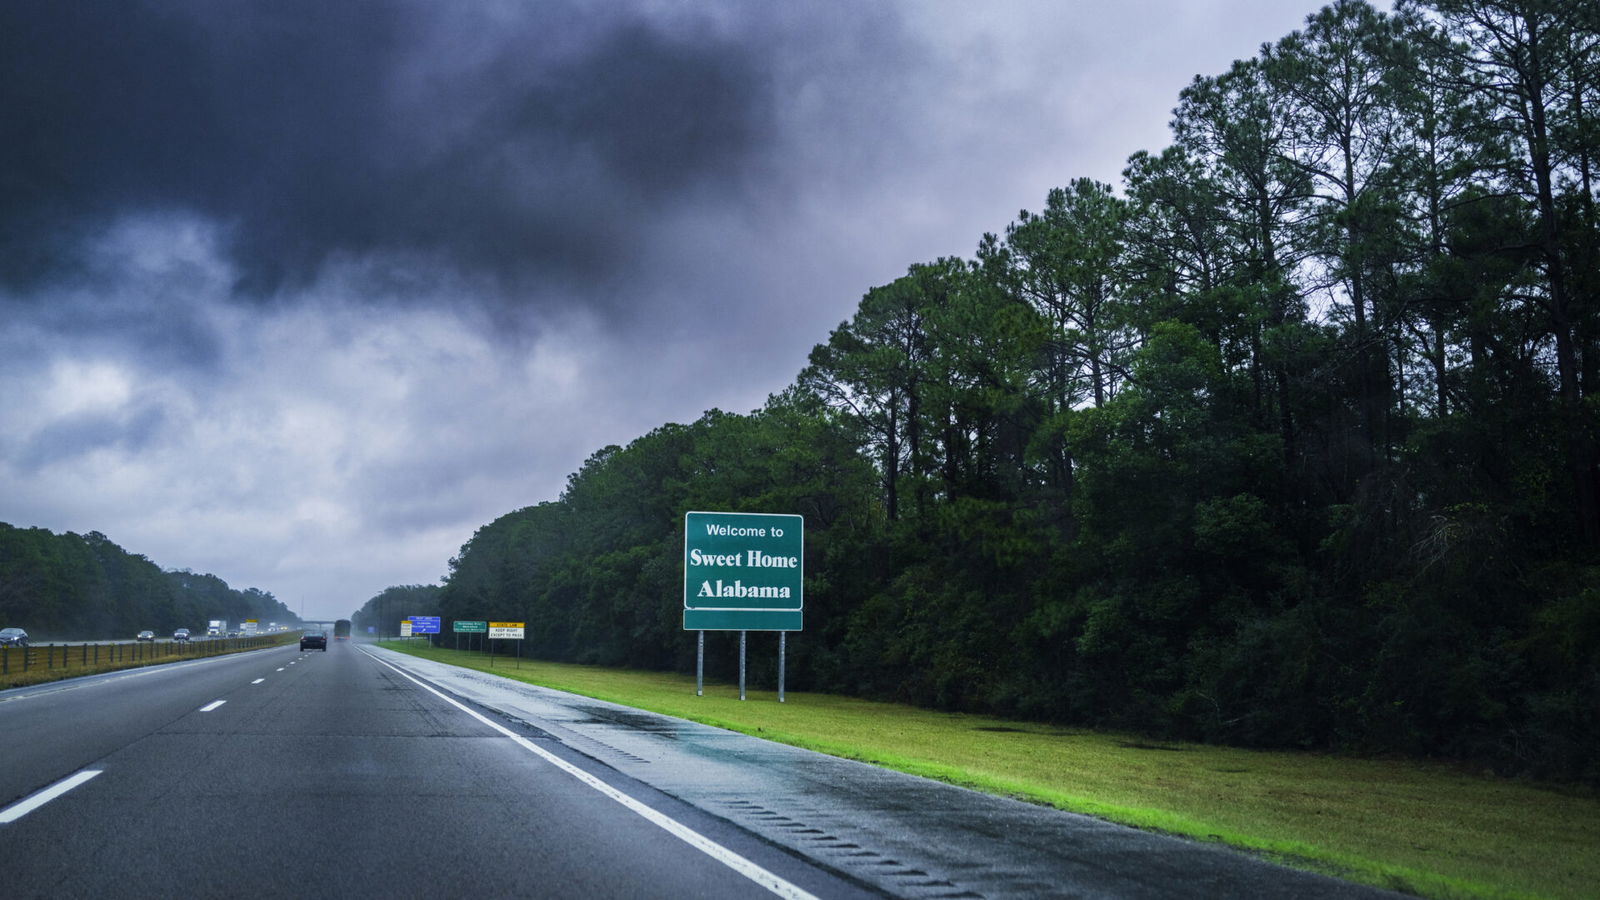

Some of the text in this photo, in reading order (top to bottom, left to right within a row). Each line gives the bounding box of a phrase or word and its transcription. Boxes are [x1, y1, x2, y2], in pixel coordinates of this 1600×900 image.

[706, 524, 784, 537] Welcome to
[690, 548, 798, 568] Sweet Home
[697, 580, 791, 599] Alabama
